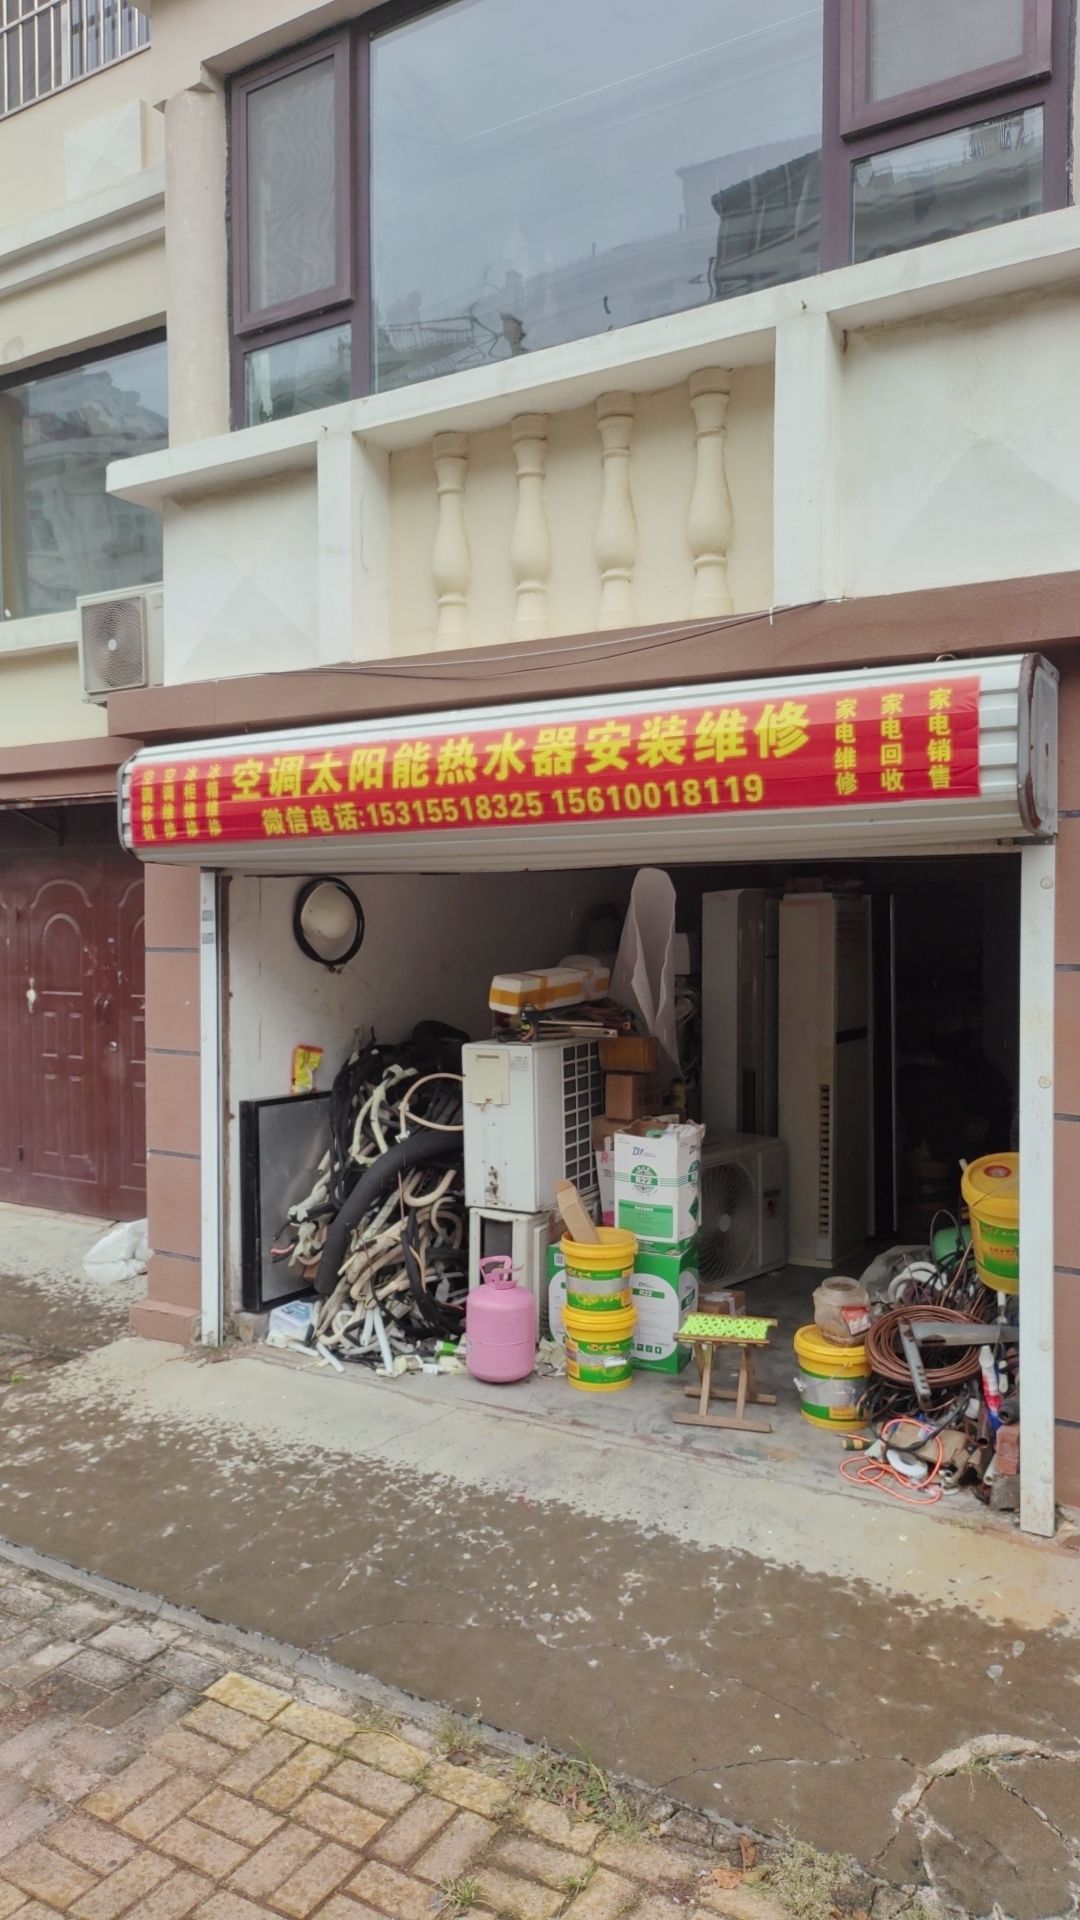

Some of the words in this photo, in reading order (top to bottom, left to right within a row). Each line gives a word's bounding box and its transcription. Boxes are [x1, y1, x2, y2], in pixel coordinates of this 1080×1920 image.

[231, 702, 811, 801] 空调太阳能热水器安装维修
[835, 699, 857, 796] 家电维修
[880, 694, 904, 792] 家电回收
[927, 688, 951, 790] 家电销售
[552, 774, 765, 815] 15610018119
